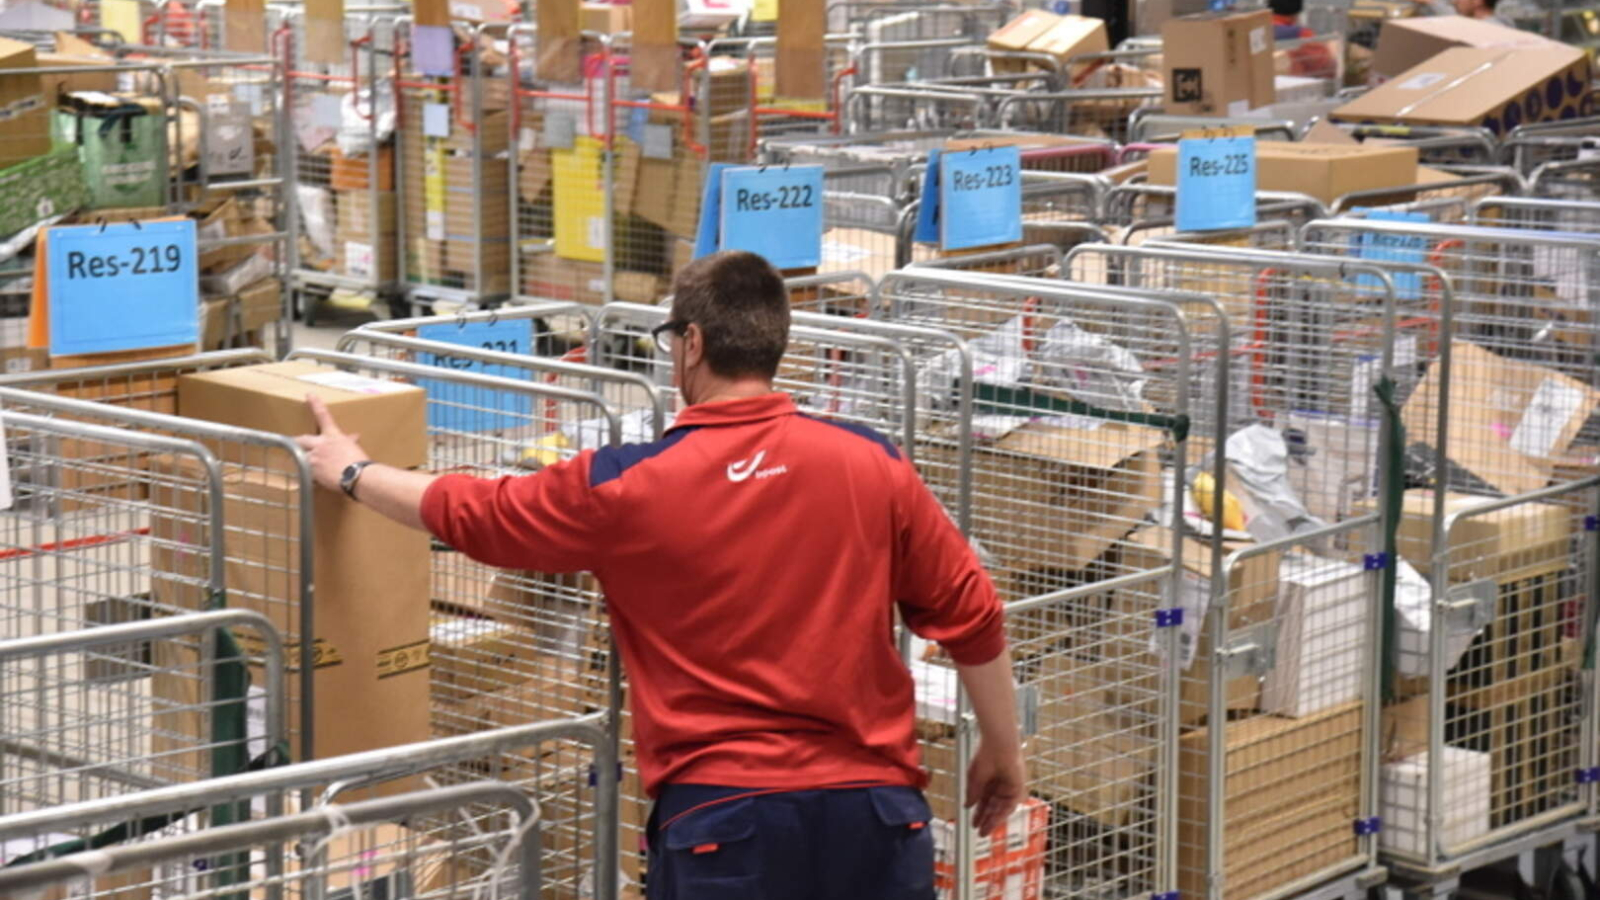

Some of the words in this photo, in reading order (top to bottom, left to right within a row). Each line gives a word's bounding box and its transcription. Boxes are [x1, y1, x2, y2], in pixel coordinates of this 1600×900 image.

[953, 164, 1013, 192] Res-223
[1190, 154, 1249, 177] Res-225
[736, 184, 813, 212] Res-222
[67, 244, 181, 279] Res-219
